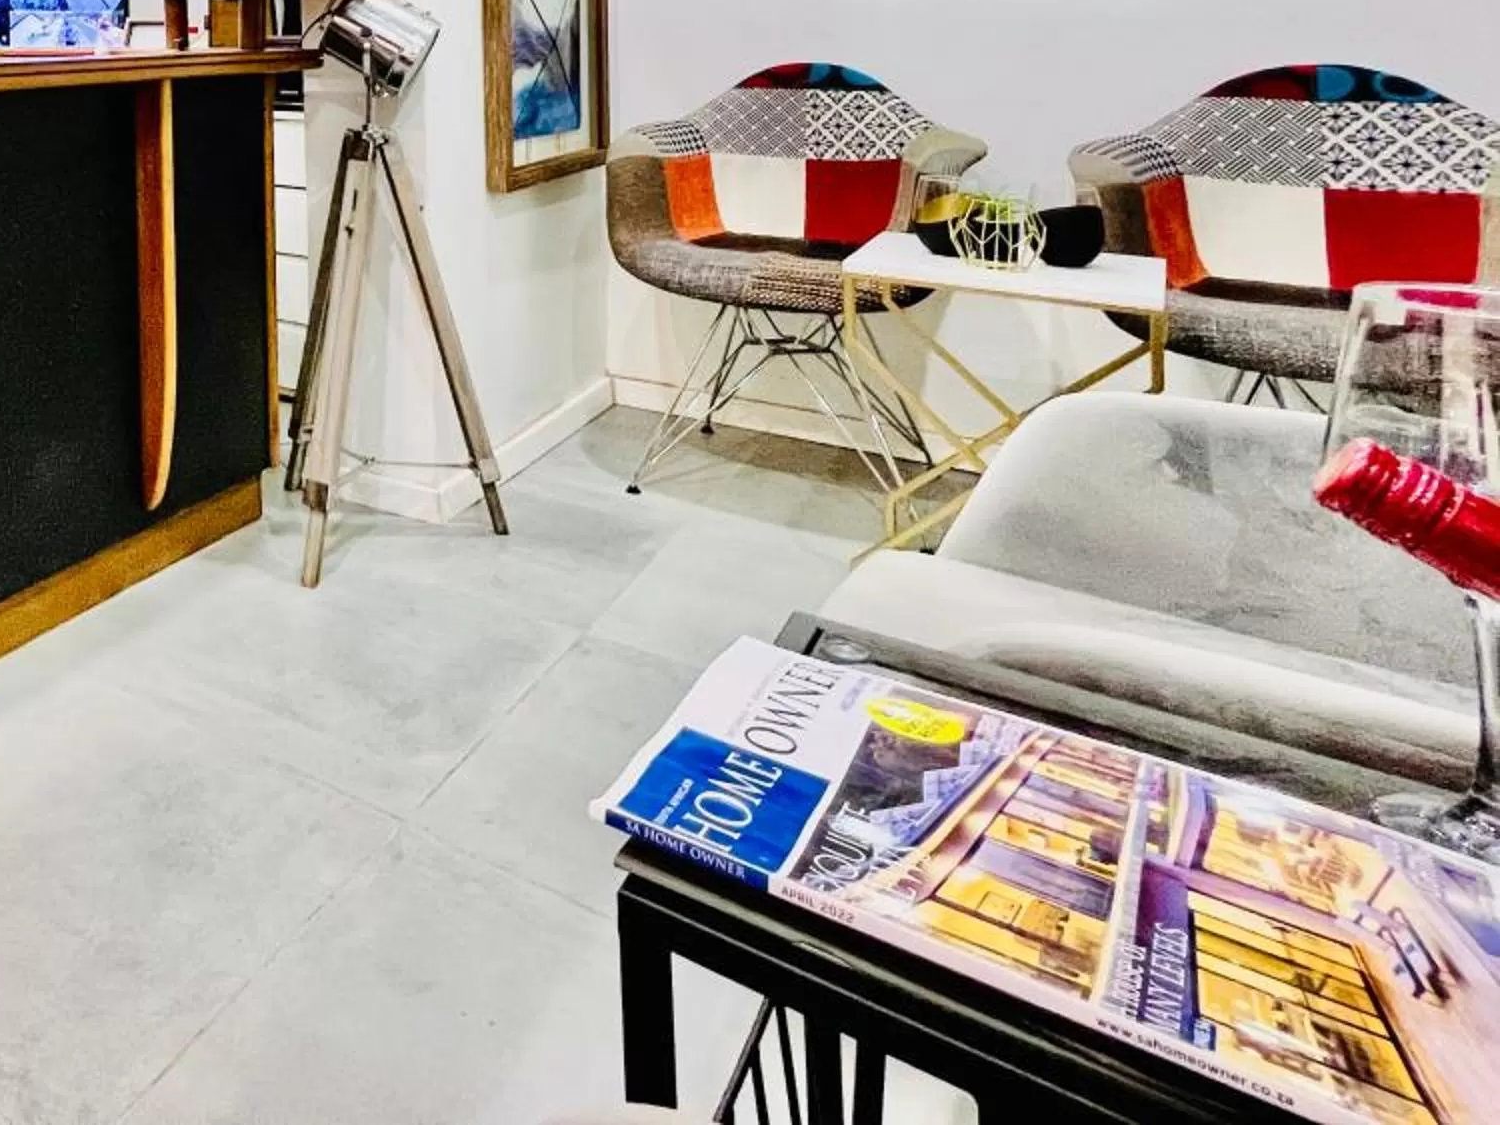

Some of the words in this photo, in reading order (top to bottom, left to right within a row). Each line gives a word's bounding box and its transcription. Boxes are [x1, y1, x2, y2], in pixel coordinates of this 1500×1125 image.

[673, 751, 783, 854] HOME
[743, 661, 844, 755] OWNER
[625, 819, 642, 836] SA
[643, 825, 687, 855] HOME
[689, 846, 746, 880] OWNER
[781, 886, 814, 908] APRIL
[819, 901, 855, 924] 2022
[1149, 922, 1190, 988] LEVELS
[1142, 977, 1184, 1034] MANY
[1096, 1018, 1296, 1107] www.sahomeowner.co.za
